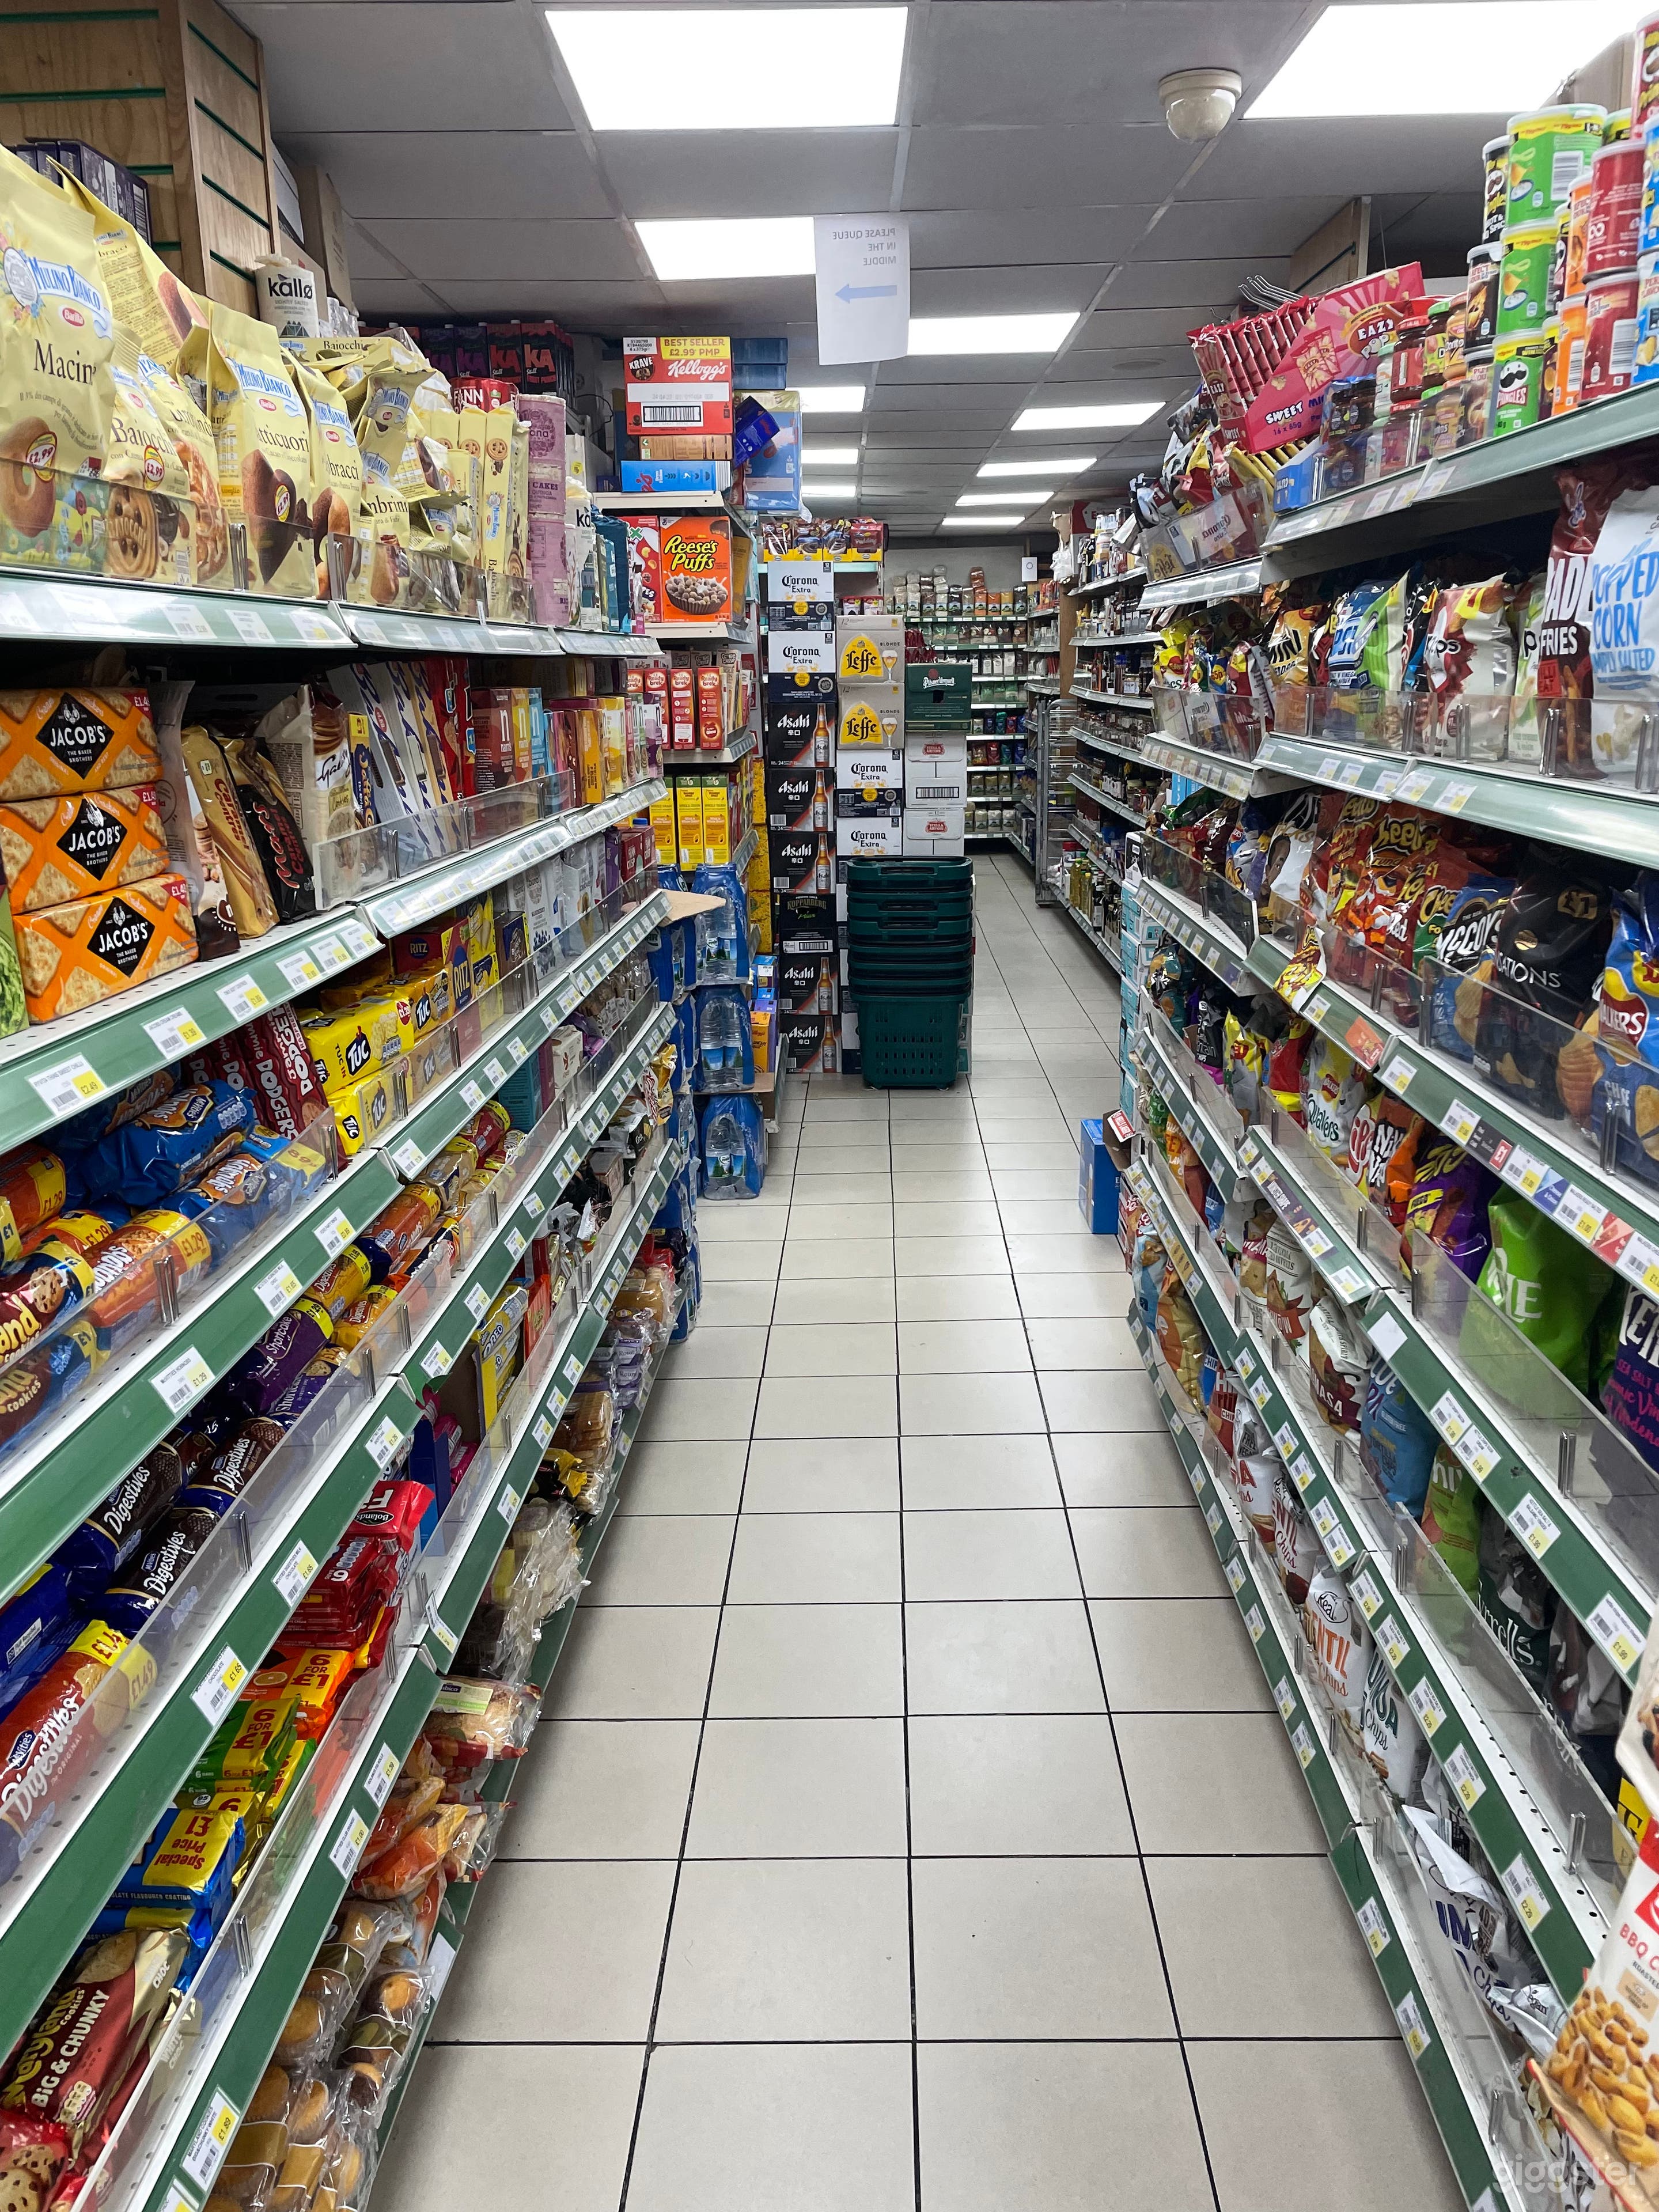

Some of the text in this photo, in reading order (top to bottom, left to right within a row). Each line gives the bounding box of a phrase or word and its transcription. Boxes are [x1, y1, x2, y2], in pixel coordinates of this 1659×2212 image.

[1358, 318, 1395, 341] EAZY
[323, 339, 364, 350] Baiocchi
[690, 338, 725, 346] SELLER
[628, 357, 653, 370] KRAVE
[668, 359, 727, 381] Kellogg's
[1265, 401, 1304, 425] SWEET
[532, 482, 559, 491] CAKES
[664, 535, 719, 554] Reese's
[671, 552, 715, 572] Puffs
[782, 574, 819, 588] Corona
[791, 585, 811, 593] Extra
[1593, 601, 1642, 650] CORN
[1540, 626, 1578, 656] FRIES
[783, 646, 820, 659] Corona
[845, 649, 877, 673] Leffe
[673, 675, 690, 683] Ready
[777, 714, 810, 728] Asahi
[846, 716, 877, 741] Leffe
[50, 725, 106, 747] JACOB'S
[851, 763, 888, 775] Corona
[778, 780, 809, 793] Asahi
[69, 825, 122, 852] JACOB'S
[850, 830, 888, 843] Corona
[781, 844, 812, 857] Asahi
[786, 899, 827, 911] KOPPARBERG
[99, 923, 148, 953] JACOB'S
[410, 943, 428, 953] RITZ
[453, 964, 470, 997] RITZ
[785, 967, 814, 979] Asahi
[417, 999, 430, 1026] TUC
[789, 1025, 818, 1038] Asahi
[335, 1043, 344, 1066] TUC
[347, 1039, 369, 1071] TUC
[315, 1060, 327, 1082] TUC
[81, 1081, 99, 1095] £2.49
[343, 1116, 359, 1139] TUC
[1308, 1098, 1339, 1142] Quavers
[180, 1232, 206, 1257] £1.29
[266, 1316, 293, 1354] Shortcake
[192, 1372, 207, 1388] £1.29
[7, 1381, 41, 1414] cookies
[213, 1437, 251, 1494] Digestives
[104, 1465, 150, 1535] Digestives
[357, 1512, 390, 1521] Bolands
[143, 1529, 186, 1596] Digestives
[91, 1630, 123, 1660] £1.4
[308, 1654, 331, 1666] 6
[229, 1662, 243, 1682] £1.65
[290, 1673, 329, 1690] £1
[252, 1708, 275, 1722] 6
[247, 1722, 272, 1733] FOR
[232, 1732, 272, 1750] £1
[58, 1733, 84, 1776] ORIGINAL
[185, 1815, 214, 1837] £1
[171, 1838, 207, 1854] Price
[153, 1854, 205, 1870] Special
[1620, 1923, 1650, 1962] BBQ
[60, 1988, 85, 2026] cookies
[60, 1988, 111, 2058] CHUNKY
[50, 2058, 71, 2075] &
